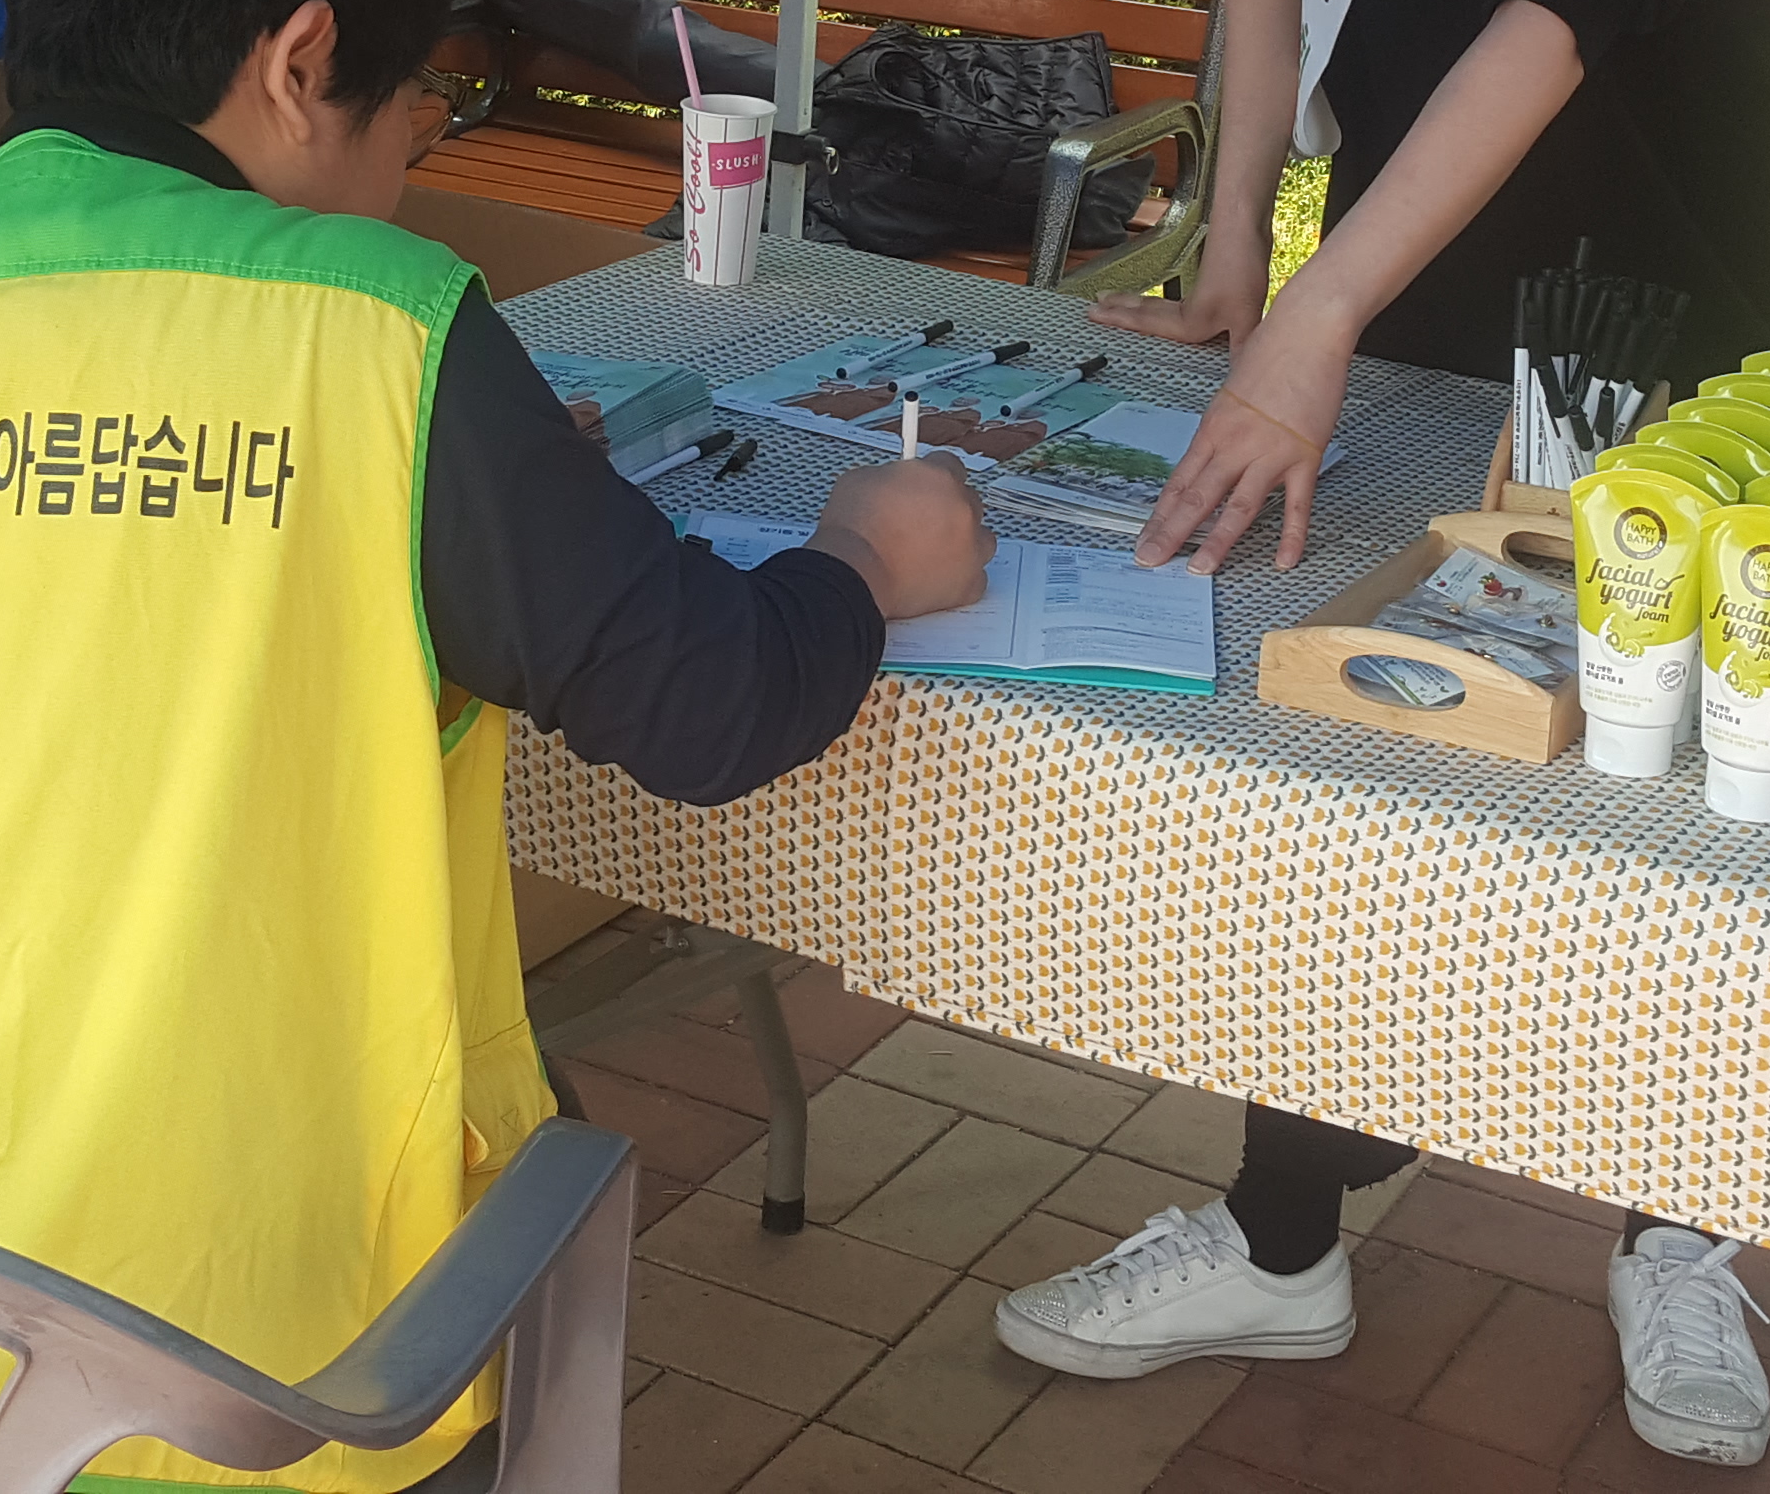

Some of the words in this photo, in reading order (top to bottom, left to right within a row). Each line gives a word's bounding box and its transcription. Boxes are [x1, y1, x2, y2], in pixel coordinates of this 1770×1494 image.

[1625, 522, 1657, 536] HAPPY
[1626, 534, 1654, 546] BATH
[1585, 558, 1654, 589] facial
[1600, 583, 1673, 610] yogurt
[1634, 607, 1669, 623] foam
